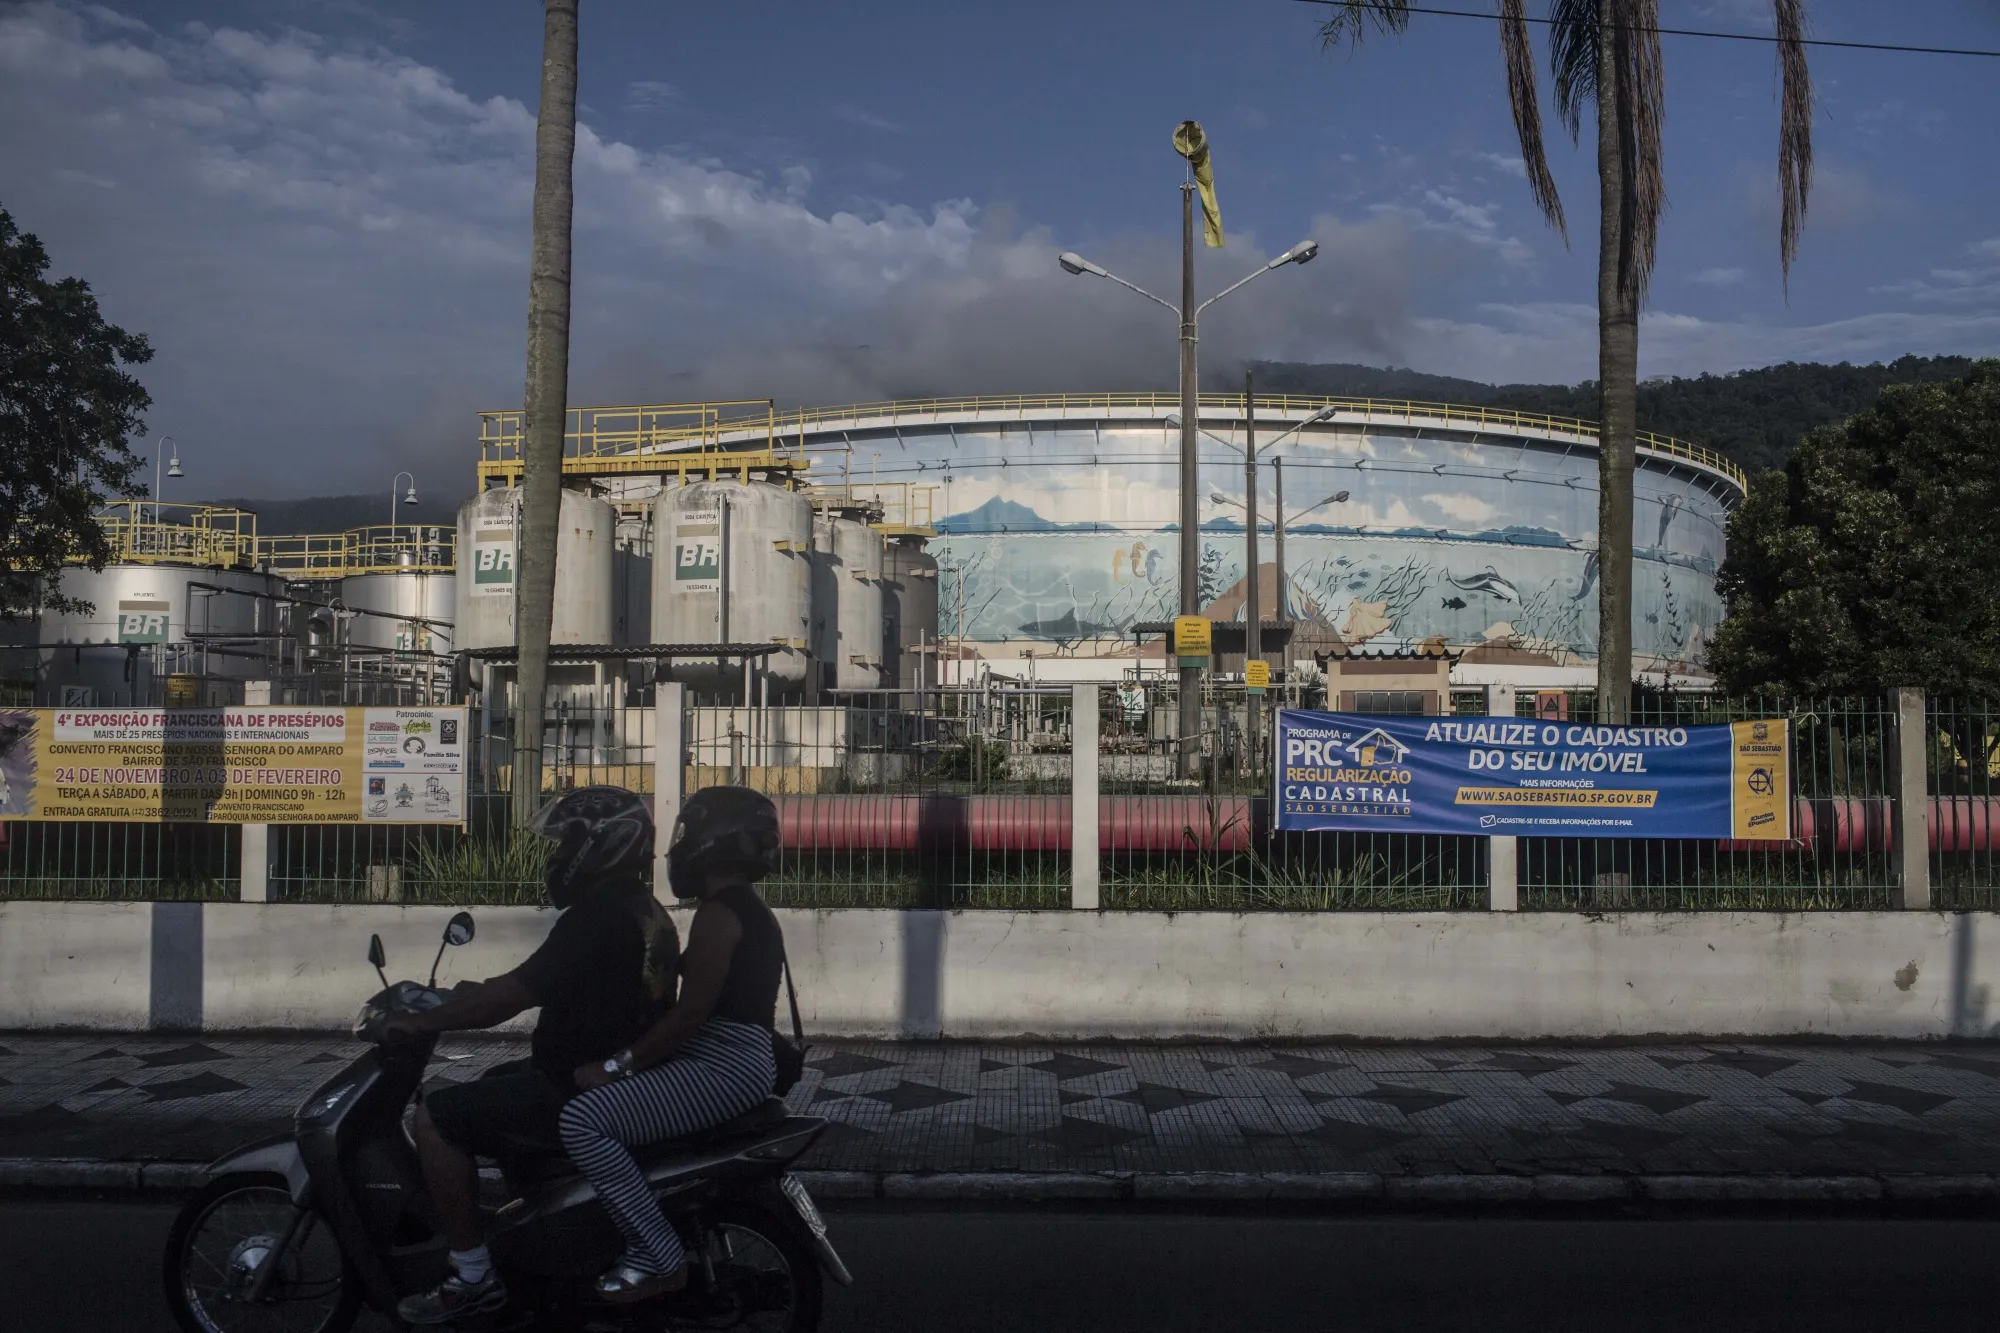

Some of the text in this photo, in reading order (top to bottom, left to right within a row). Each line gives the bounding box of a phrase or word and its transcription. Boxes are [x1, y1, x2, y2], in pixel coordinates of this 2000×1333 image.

[479, 549, 513, 571] BR
[680, 544, 719, 566] BR
[122, 614, 164, 635] BR
[58, 712, 344, 729] 4ª EXPOSIÇÃO FRANCISCANA DE PRESÉPIOS
[94, 730, 115, 738] MAIS
[141, 729, 185, 739] PRESÉPIOS
[188, 731, 232, 740] NACIONAIS
[241, 731, 310, 740] INTERNACIONAIS
[1287, 728, 1340, 739] PROGRAMA
[1425, 722, 1687, 747] ATUALIZE O CADASTRO
[49, 745, 343, 756] CONVENTO FRANCISCANO NOSSA SENHORA DO AMPARO
[1287, 739, 1342, 766] PRC
[1740, 744, 1751, 752] SÃO
[123, 755, 267, 766] BAIRRO DE SÃO FRANCISCO
[1468, 747, 1647, 773] DO SEU IMÓVEL
[55, 768, 342, 785] 24 DE NOVEMBRO A 03 DE FEVEREIRO
[1286, 767, 1411, 787] REGULARIZAÇÃO
[1540, 779, 1594, 789] INFORMAÇÕES
[57, 788, 92, 801] TERÇA
[93, 788, 100, 798] A
[102, 786, 149, 800] SÁBADO,
[152, 788, 159, 799] A
[162, 789, 197, 799] PARTIR
[201, 789, 222, 800] DAS
[225, 789, 237, 800] 9h
[245, 789, 298, 800] DOMINGO
[301, 789, 314, 800] 9h
[326, 790, 345, 800] 12h
[1285, 786, 1411, 802] CADASTRAL
[1461, 791, 1652, 804] WWW.SAOSEBASTIAO.SP.GOV.BR
[43, 807, 85, 817] ENTRADA
[87, 807, 130, 817] GRATUITA
[1286, 803, 1410, 815] SÃO SEBASTIÃO
[213, 812, 250, 821] PARÓQUIA
[1561, 818, 1601, 826] INFORMAÇÕES
